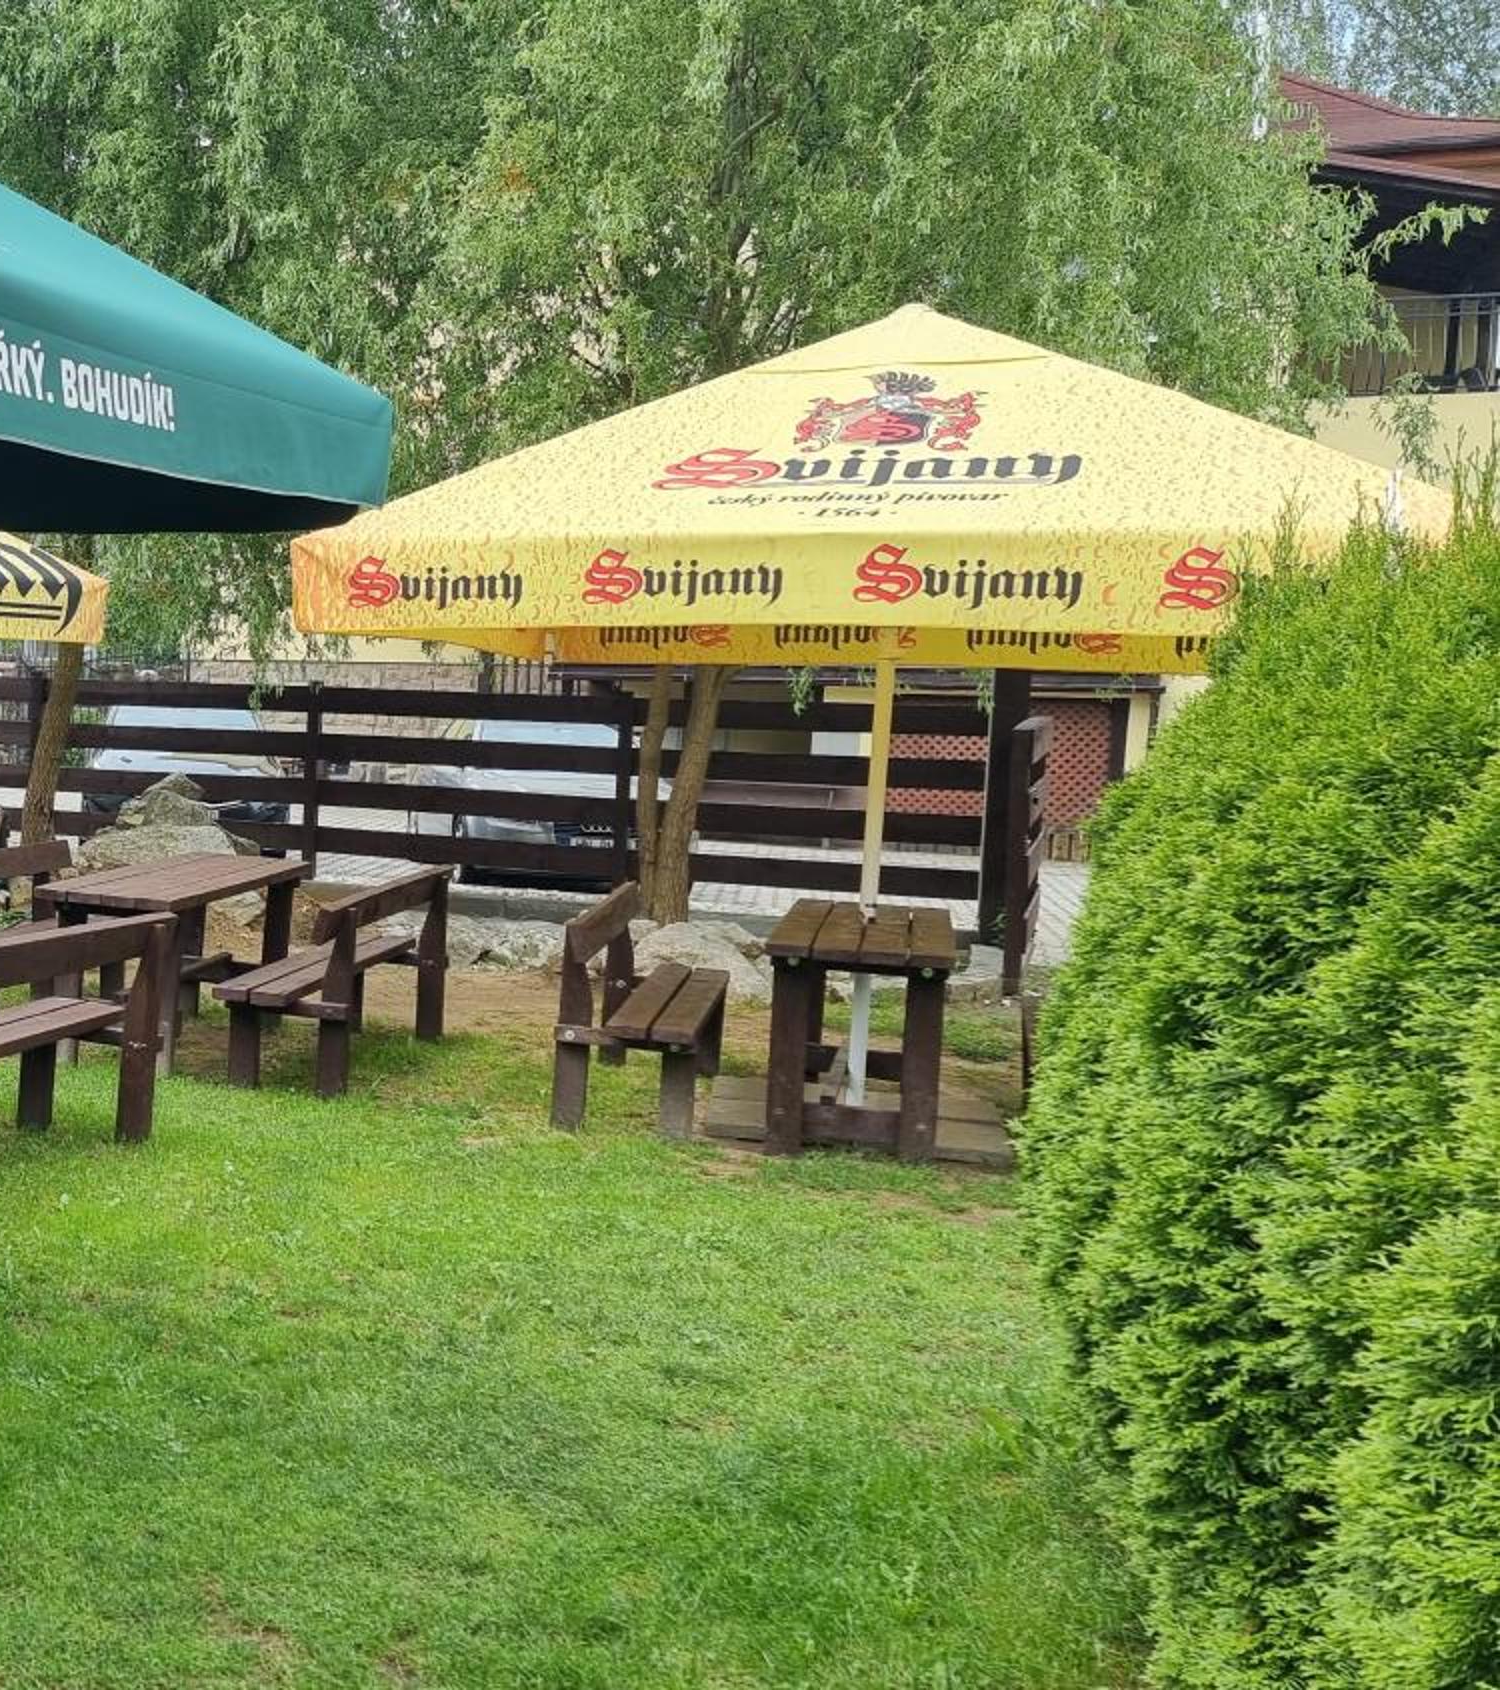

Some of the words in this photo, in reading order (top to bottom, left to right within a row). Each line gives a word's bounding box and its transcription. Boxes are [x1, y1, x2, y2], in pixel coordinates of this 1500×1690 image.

[60, 357, 176, 432] BOHUDÍK!
[651, 447, 1083, 490] Svijany
[347, 555, 523, 609] Svijany
[582, 548, 783, 606] Svijany
[853, 543, 1083, 611] Svijany
